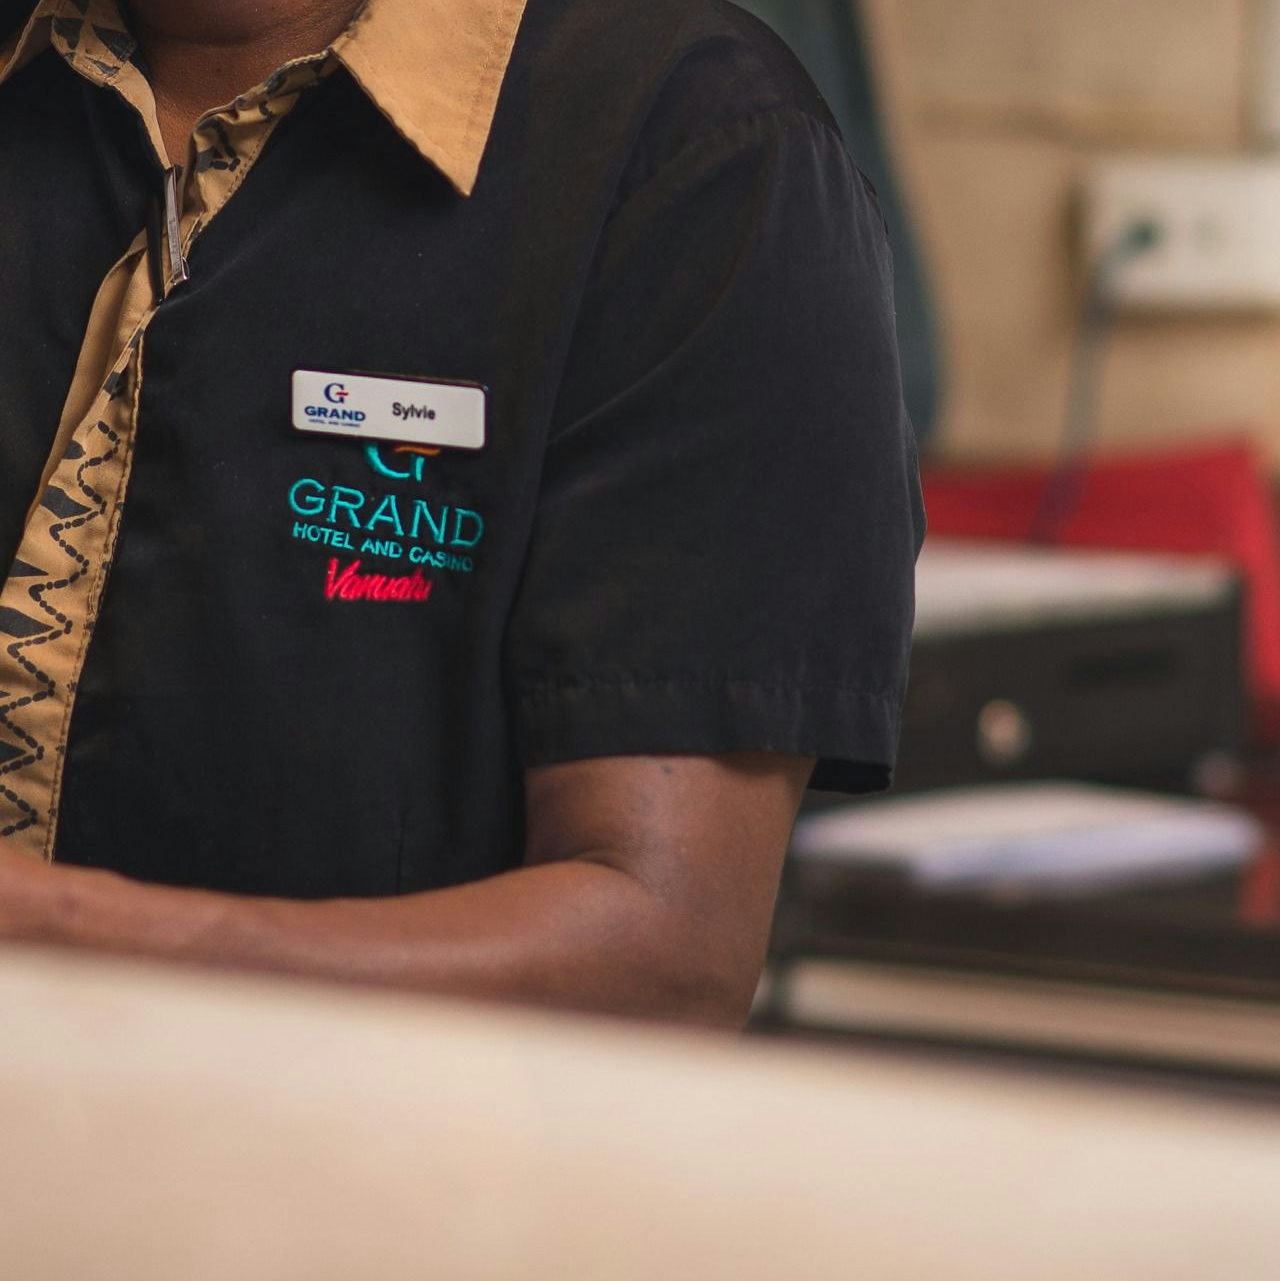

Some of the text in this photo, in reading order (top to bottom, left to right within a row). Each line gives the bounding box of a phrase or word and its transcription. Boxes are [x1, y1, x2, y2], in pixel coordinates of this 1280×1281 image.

[304, 406, 366, 421] GRAND
[392, 402, 436, 420] Sylvie
[288, 478, 484, 547] GRAND
[292, 522, 473, 572] HOTEL AND CASINO
[325, 557, 432, 601] Vanuatu
